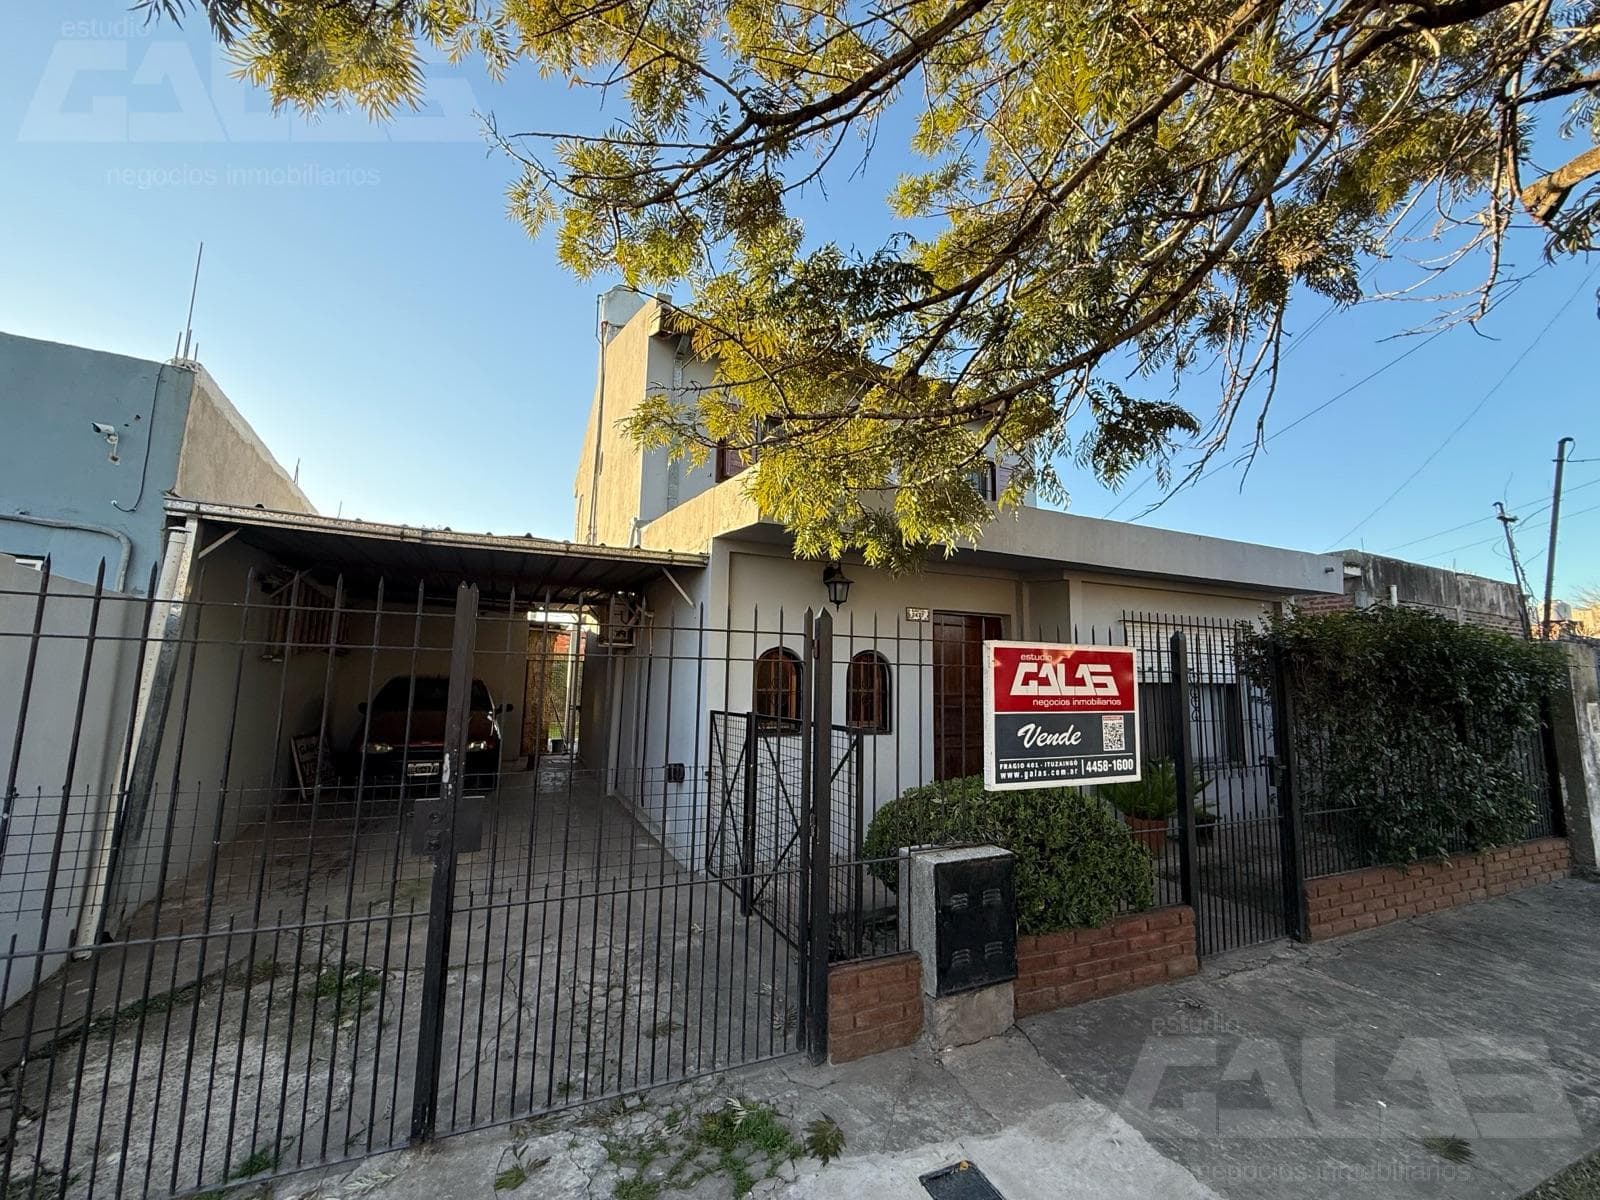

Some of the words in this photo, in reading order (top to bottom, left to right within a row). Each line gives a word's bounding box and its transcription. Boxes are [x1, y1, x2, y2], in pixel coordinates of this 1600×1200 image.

[1020, 653, 1053, 662] estudio
[1010, 662, 1119, 696] GALAS
[1032, 699, 1071, 708] negocios
[1072, 698, 1122, 706] inmobiliarios
[1017, 723, 1082, 749] Vende
[1085, 758, 1134, 773] 4458-1600
